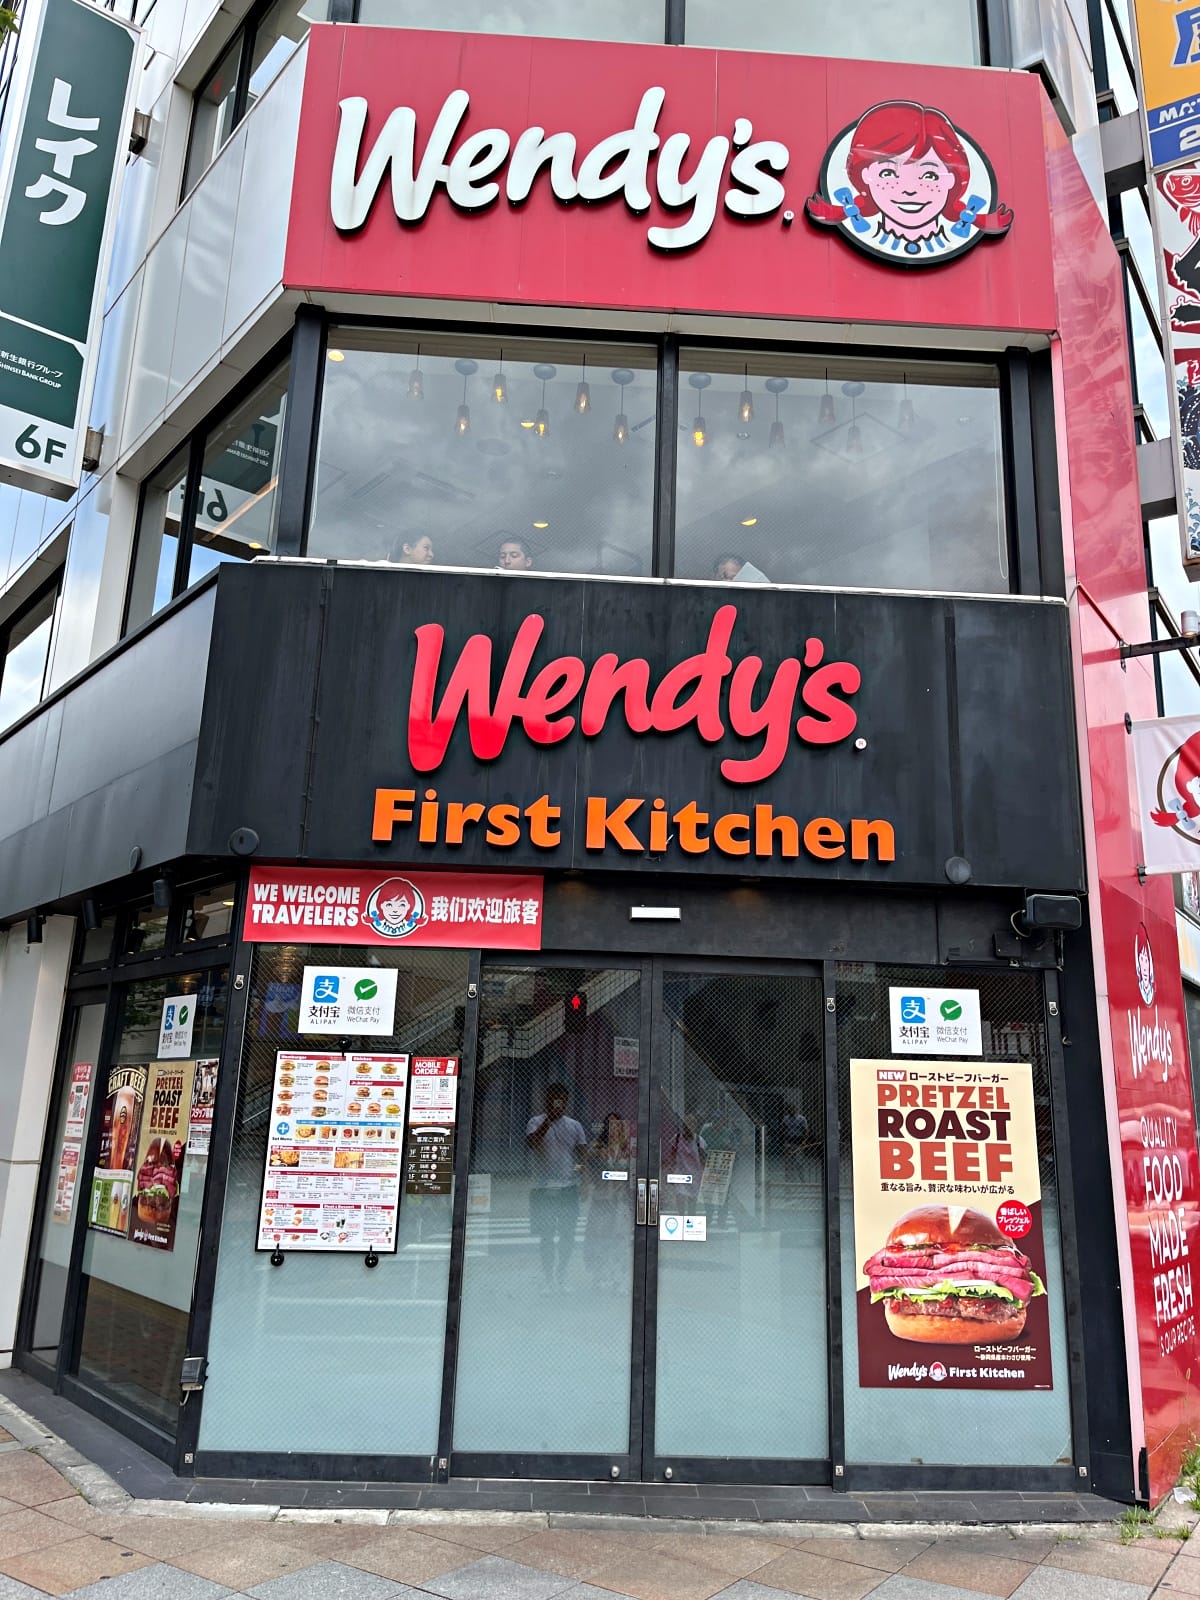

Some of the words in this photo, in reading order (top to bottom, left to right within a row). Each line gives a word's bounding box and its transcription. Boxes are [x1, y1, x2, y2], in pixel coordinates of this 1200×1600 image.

[25, 77, 100, 226] レイク
[330, 86, 790, 251] Wendy's
[21, 369, 39, 381] BANK
[38, 376, 62, 389] GROUP
[15, 423, 67, 465] 6F
[407, 604, 862, 784] Wendy's
[371, 788, 561, 849] First
[586, 797, 896, 862] Kitchen
[253, 883, 279, 902] WE
[282, 885, 360, 905] WELCOME
[252, 903, 359, 926] TRAVELERS
[431, 896, 539, 925] 我们欢迎旅客
[308, 1006, 340, 1018] 支付宝
[347, 1006, 380, 1016] 微信支付
[369, 1017, 380, 1025] Pay
[899, 1026, 930, 1038] 支付宝
[937, 1026, 968, 1036] 微信支付
[1127, 1005, 1173, 1083] Wendy's
[414, 1061, 440, 1069] MOBILE
[878, 1071, 906, 1081] NEW
[155, 1077, 184, 1089] PRETZEL
[909, 1072, 1009, 1083] ローストビーフバーガー
[152, 1090, 182, 1107] ROAST
[877, 1083, 1010, 1110] PRETZEL
[149, 1107, 180, 1129] BEEF
[878, 1108, 1011, 1141] ROAST
[1140, 1115, 1177, 1149] QUALITY
[879, 1140, 1013, 1182] BEEF
[880, 1182, 1015, 1195] 重なる旨み、贅沢な味わいが広がる
[1143, 1154, 1183, 1209] FOOD
[1147, 1207, 1189, 1269] MADE
[1153, 1262, 1193, 1328] FRESH
[974, 1345, 1036, 1353] ローストビーフバーガー
[888, 1362, 927, 1382] Wendy's
[950, 1367, 977, 1378] First
[979, 1367, 1025, 1379] Kitchen
